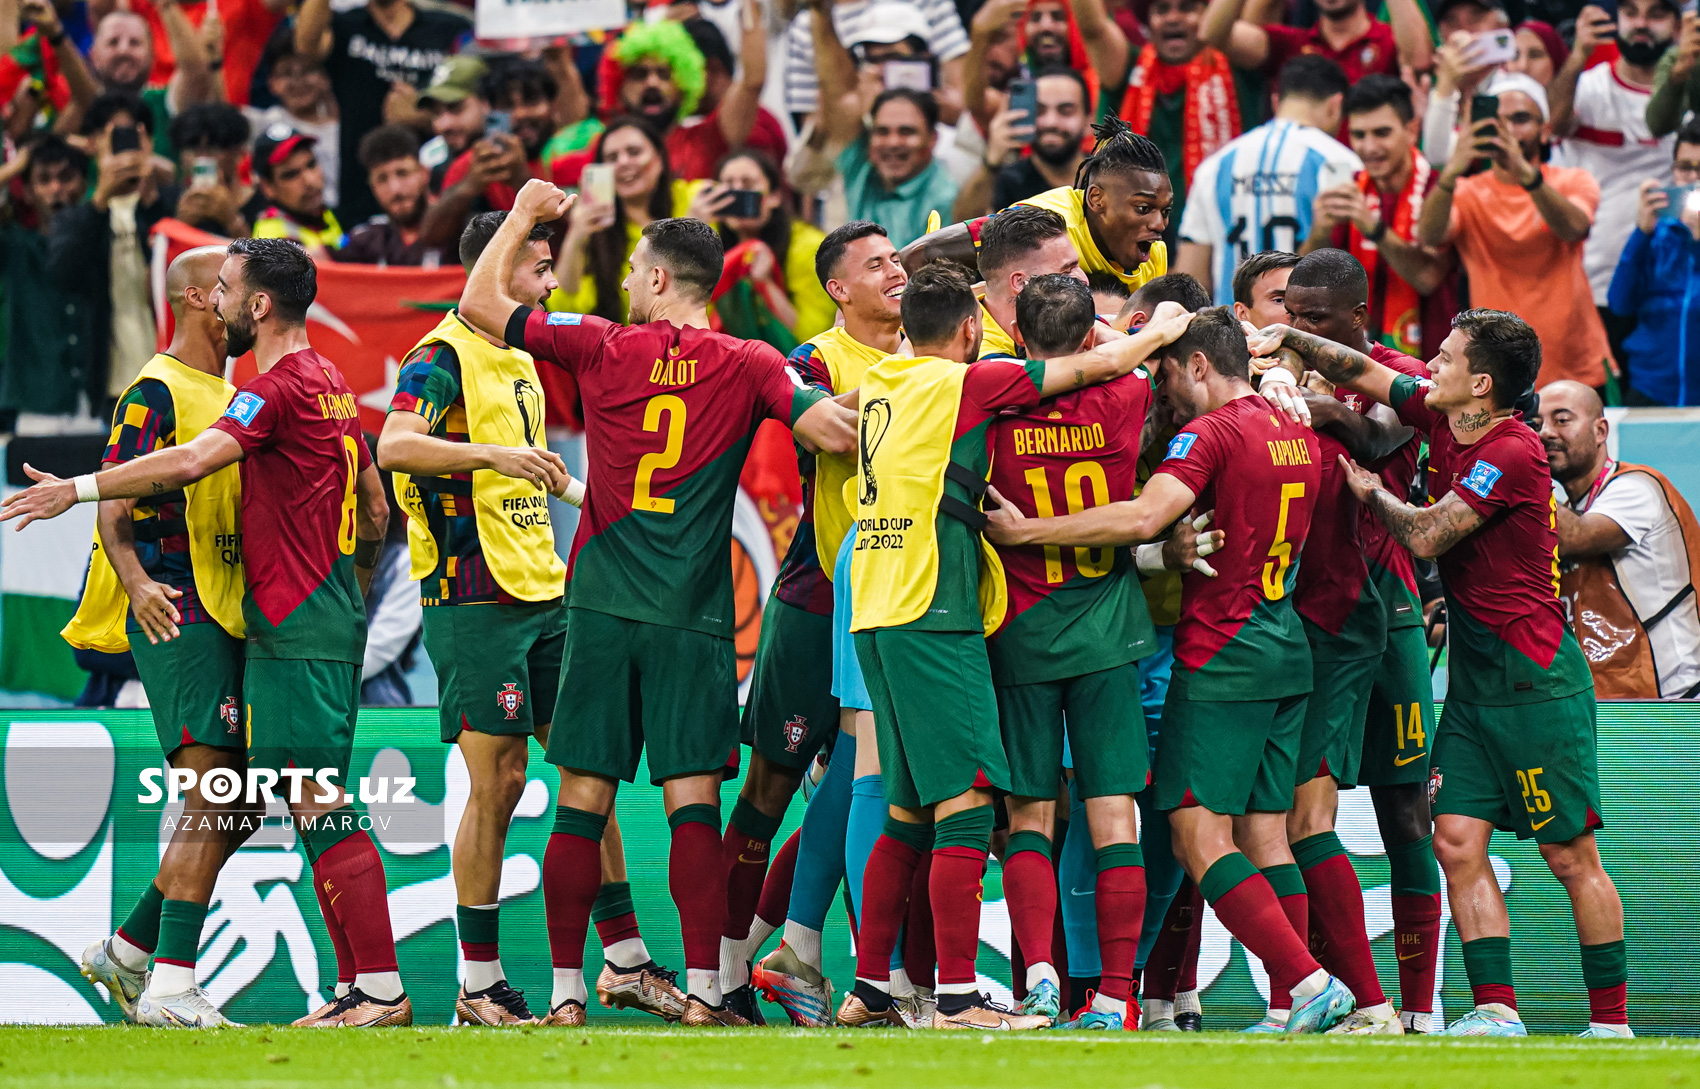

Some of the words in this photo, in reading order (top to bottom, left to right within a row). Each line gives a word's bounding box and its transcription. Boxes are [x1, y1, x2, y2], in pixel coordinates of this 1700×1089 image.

[649, 358, 698, 386] DALOT
[631, 394, 687, 514] 2
[1013, 422, 1106, 456] BERNARDO
[1267, 438, 1312, 466] RAPHAEL
[502, 497, 530, 511] FIFA
[890, 517, 914, 531] CUP
[1024, 460, 1115, 584] 10
[870, 533, 904, 549] 2022
[1261, 482, 1306, 601] 5
[1393, 702, 1426, 750] 14
[1516, 767, 1552, 813] 25
